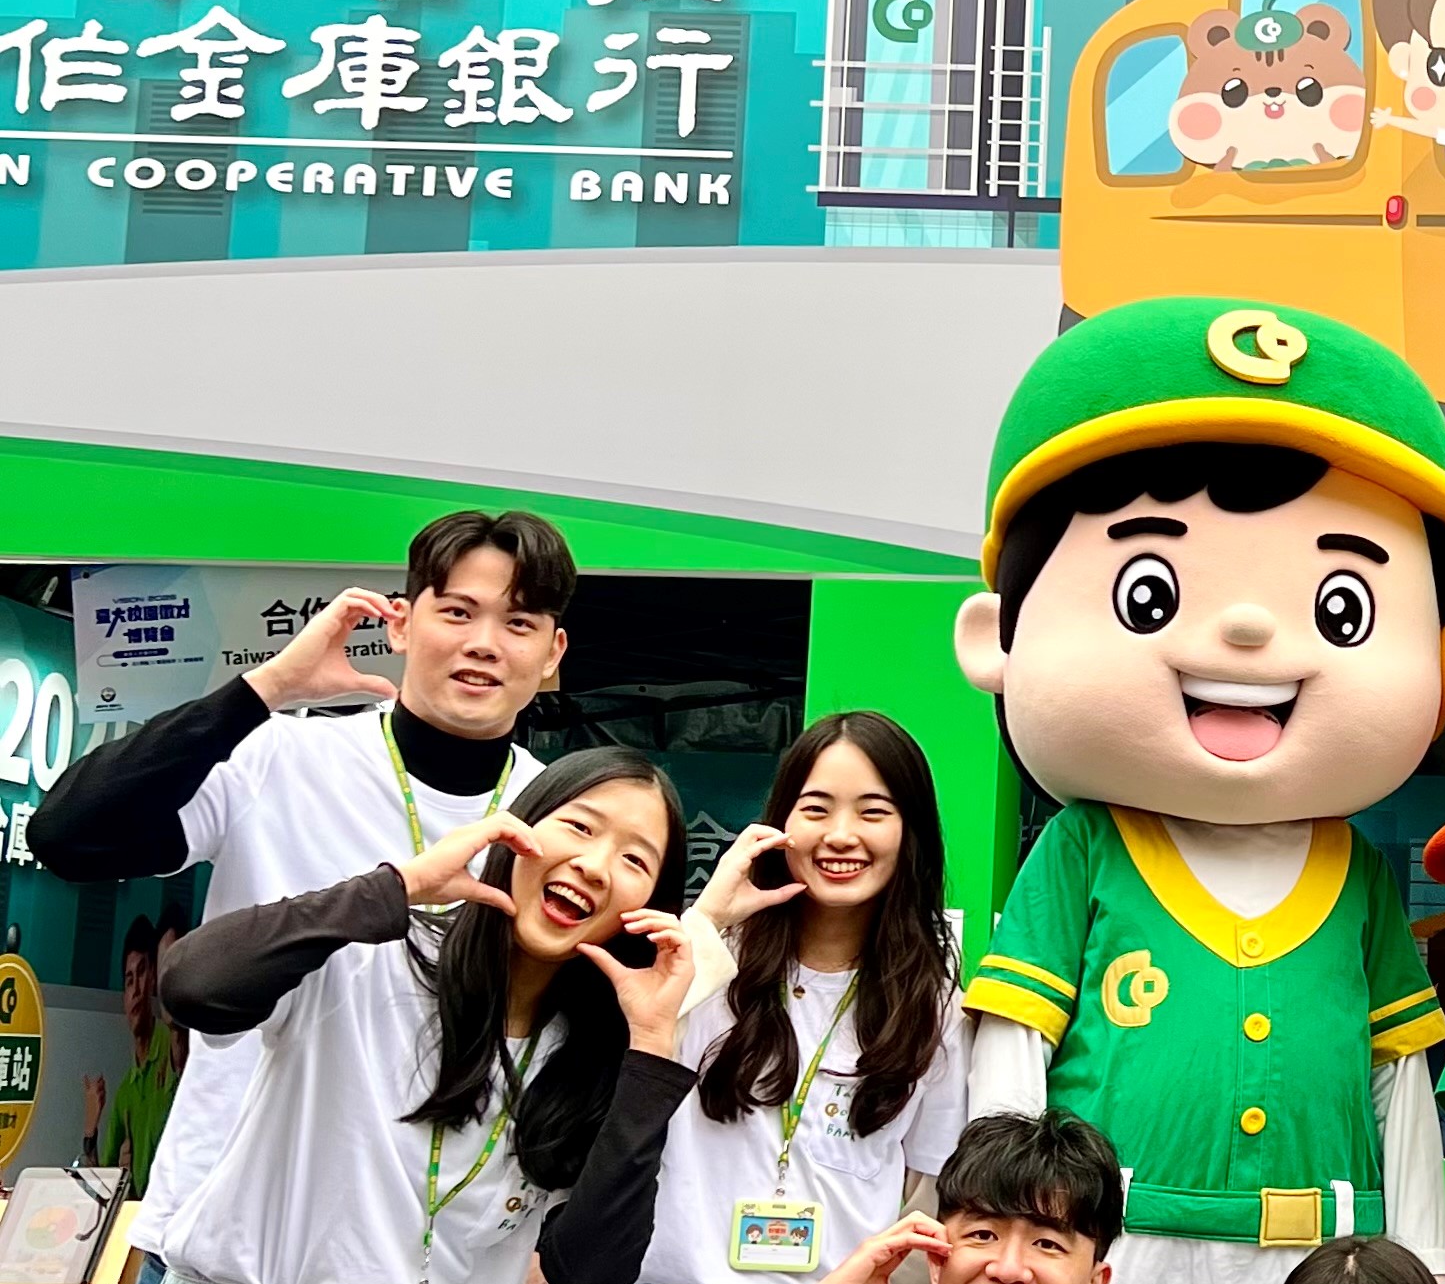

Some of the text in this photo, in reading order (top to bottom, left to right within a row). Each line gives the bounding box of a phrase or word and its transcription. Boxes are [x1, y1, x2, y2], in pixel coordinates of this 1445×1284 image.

[87, 156, 514, 200] COOPERATIVE
[569, 169, 733, 206] BANK
[222, 648, 283, 666] Taiwa
